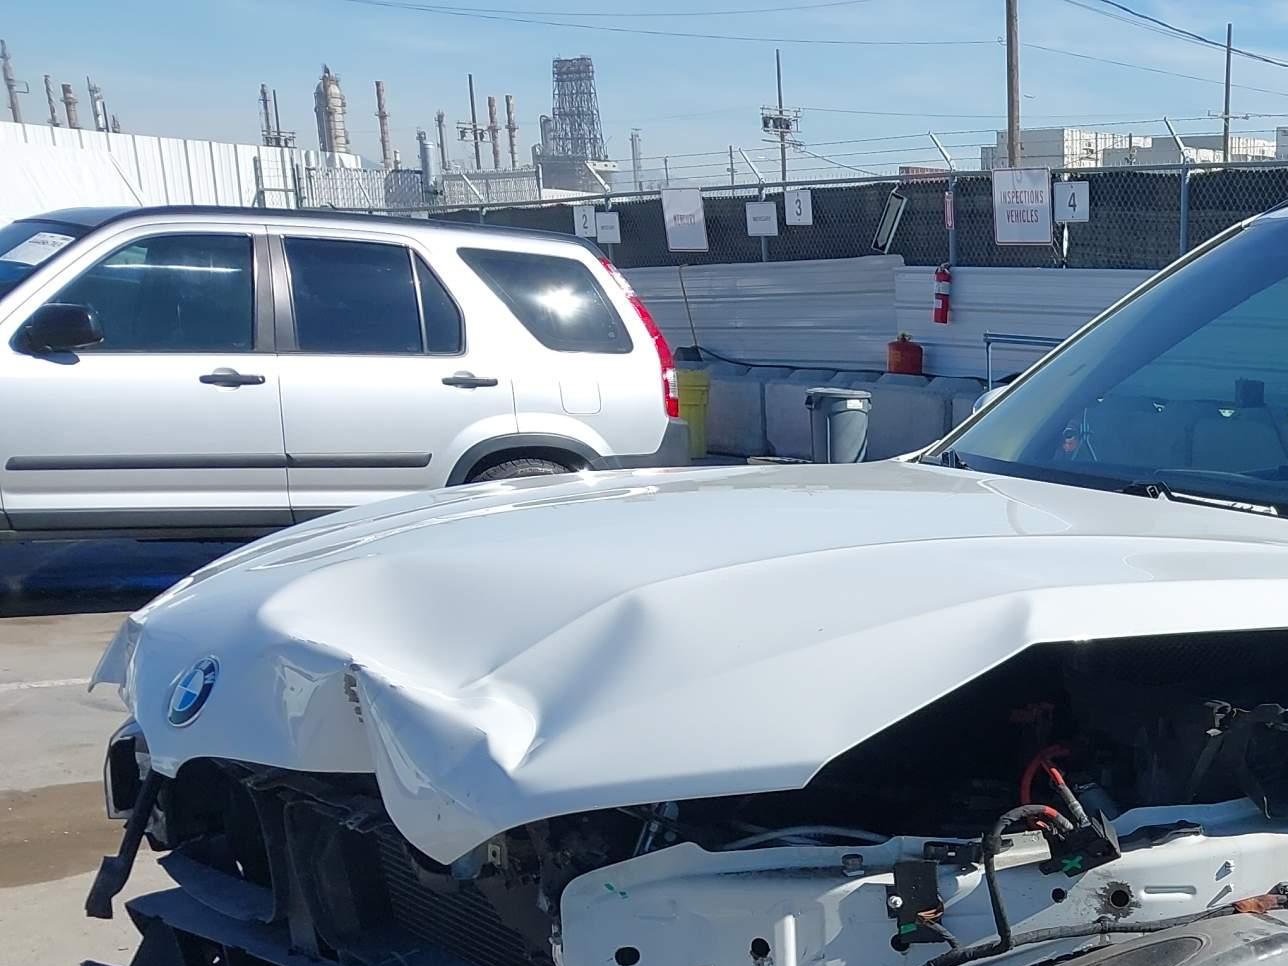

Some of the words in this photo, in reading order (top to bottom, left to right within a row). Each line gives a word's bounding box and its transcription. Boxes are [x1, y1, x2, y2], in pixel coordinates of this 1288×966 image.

[1001, 190, 1043, 205] INSPECTIONS
[1068, 192, 1077, 212] 4
[794, 199, 803, 216] 3
[582, 213, 589, 230] 2
[1006, 209, 1039, 224] VEHICLES
